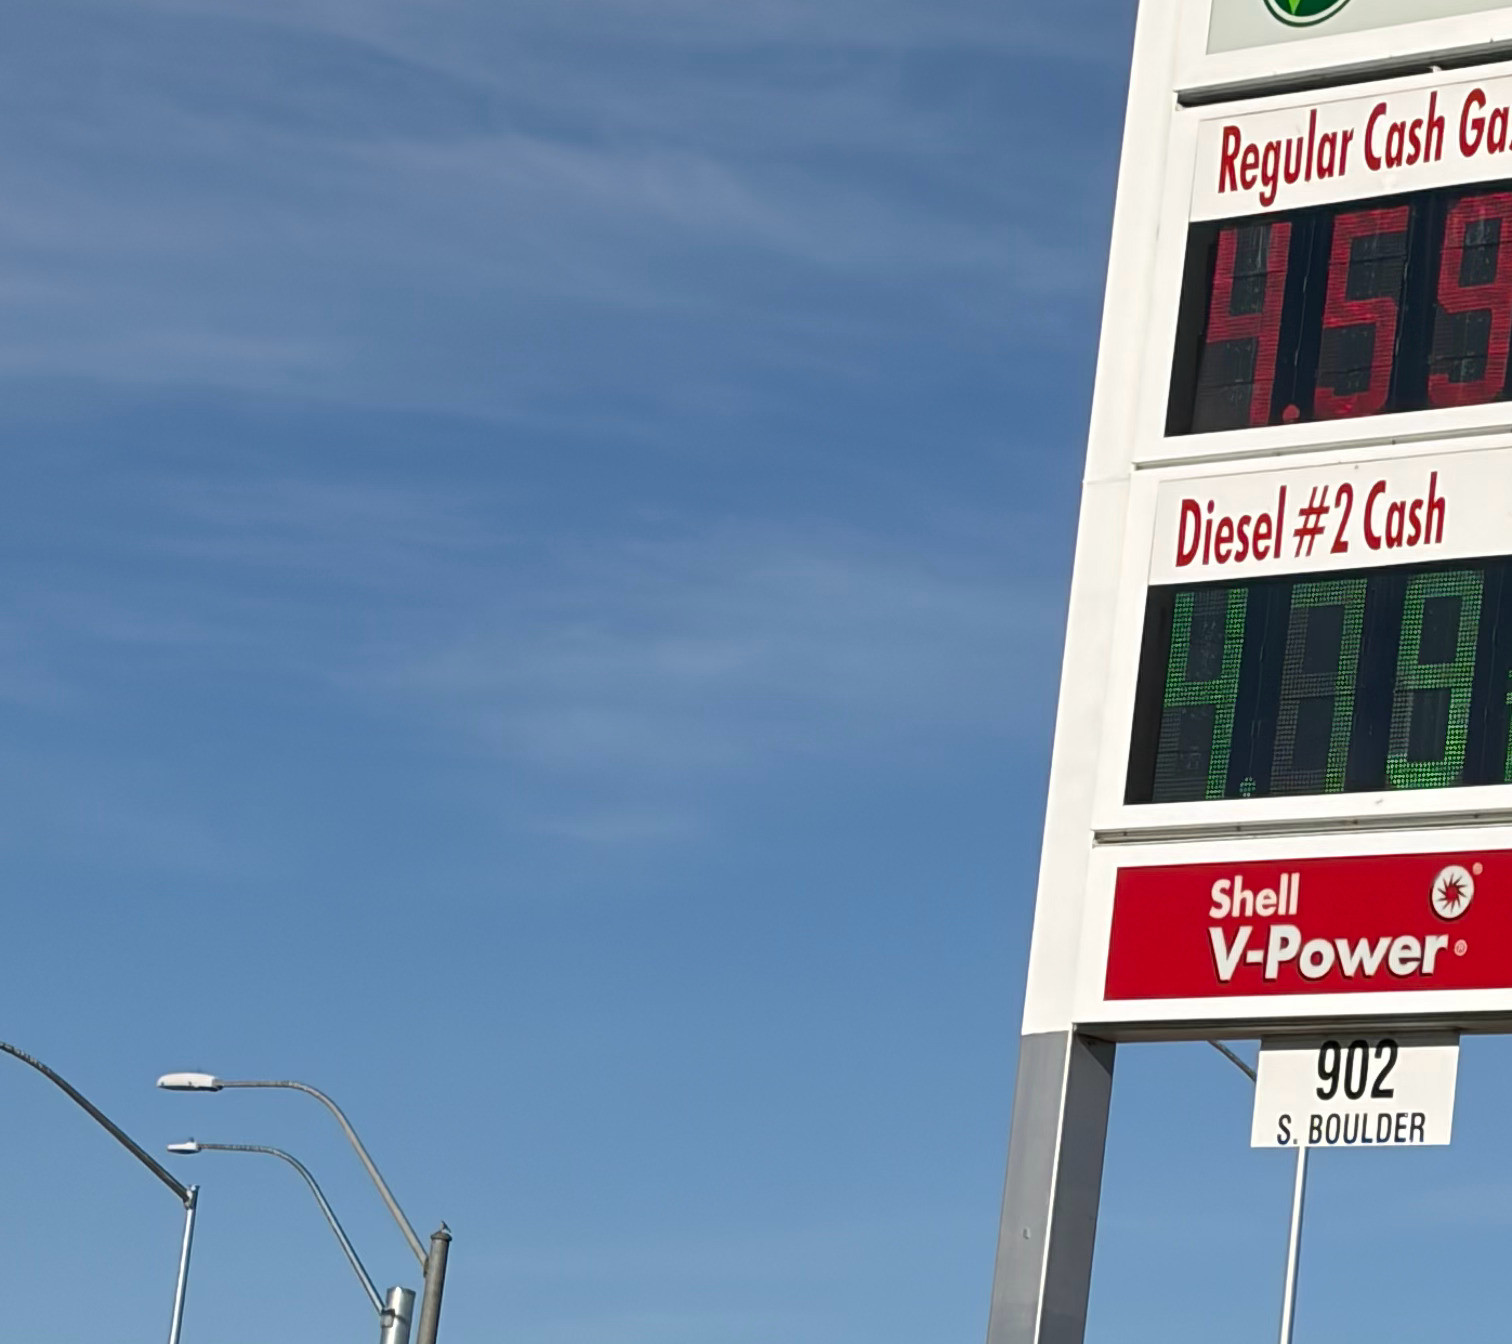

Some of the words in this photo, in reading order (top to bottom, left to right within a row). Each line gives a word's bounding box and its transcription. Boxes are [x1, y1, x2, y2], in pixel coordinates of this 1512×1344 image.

[1217, 108, 1355, 208] Regular
[1364, 89, 1444, 171] Cash
[1175, 484, 1287, 568] Diesel
[1293, 482, 1354, 557] #2
[1363, 471, 1446, 552] Cash
[1208, 873, 1300, 919] Shell
[1208, 924, 1449, 983] V-Power
[1315, 1038, 1400, 1101] 902
[1276, 1114, 1298, 1146] S.
[1308, 1111, 1427, 1145] BOULDER
